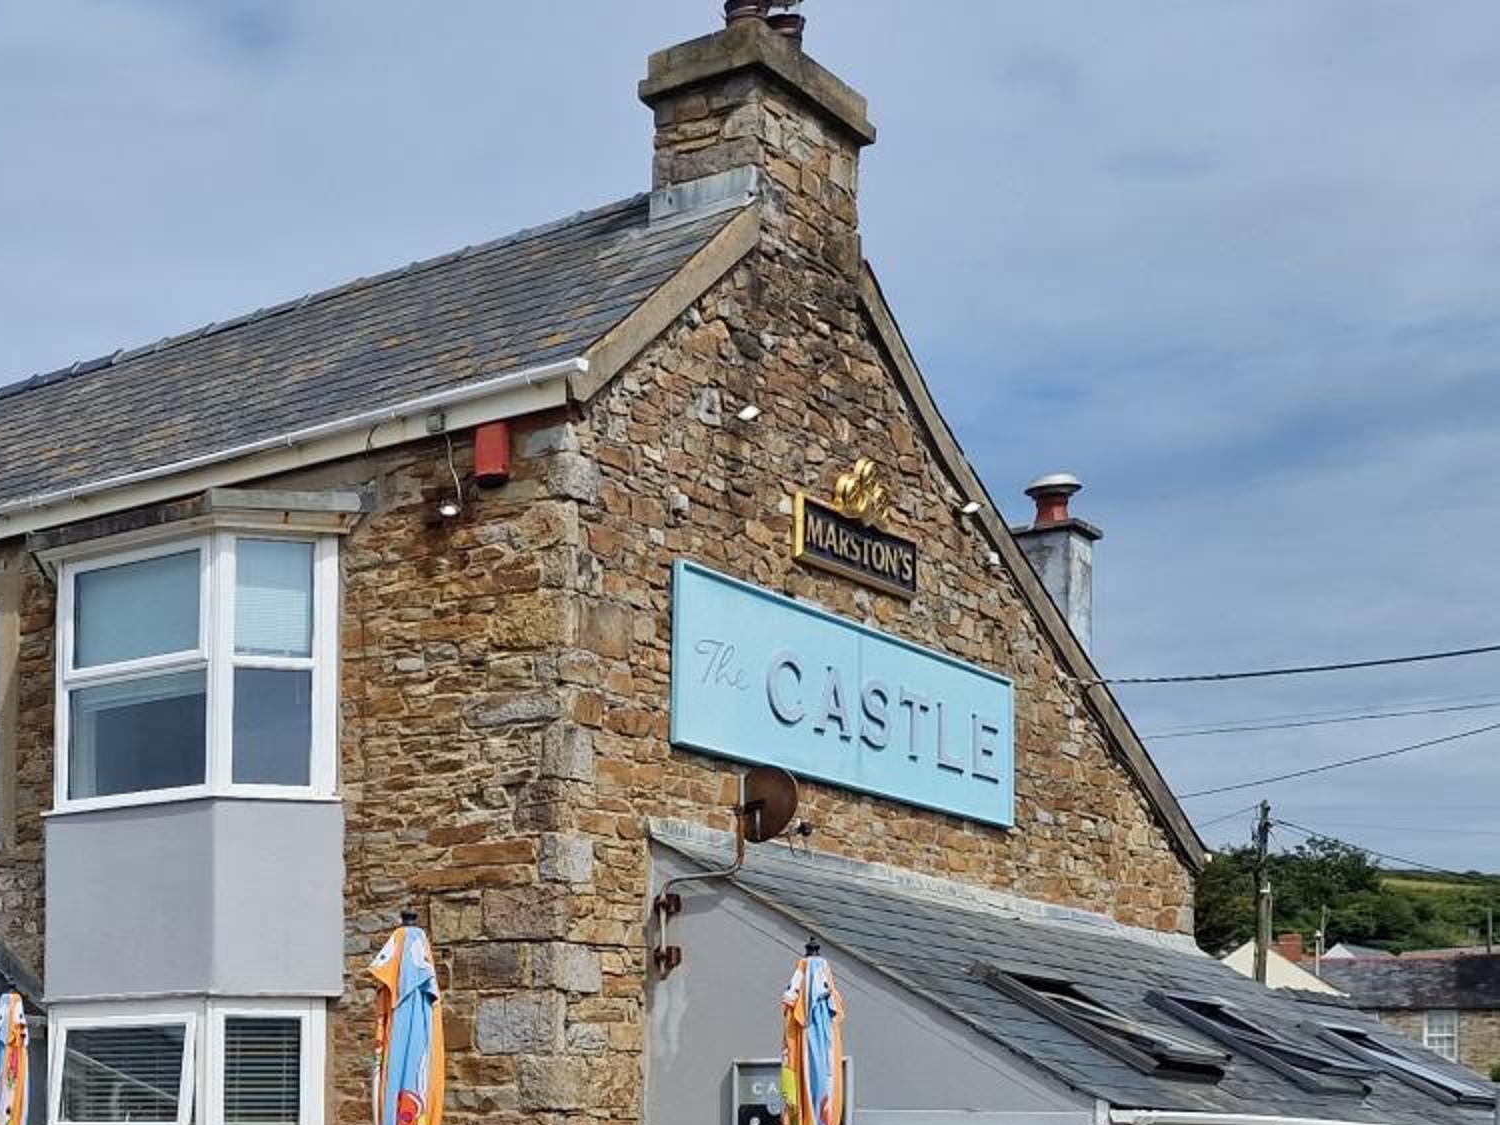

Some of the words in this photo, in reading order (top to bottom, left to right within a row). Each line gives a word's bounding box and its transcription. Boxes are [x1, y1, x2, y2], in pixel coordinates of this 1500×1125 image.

[805, 520, 913, 582] MARSTON'S
[694, 638, 749, 692] The
[765, 649, 1000, 785] CASTLE
